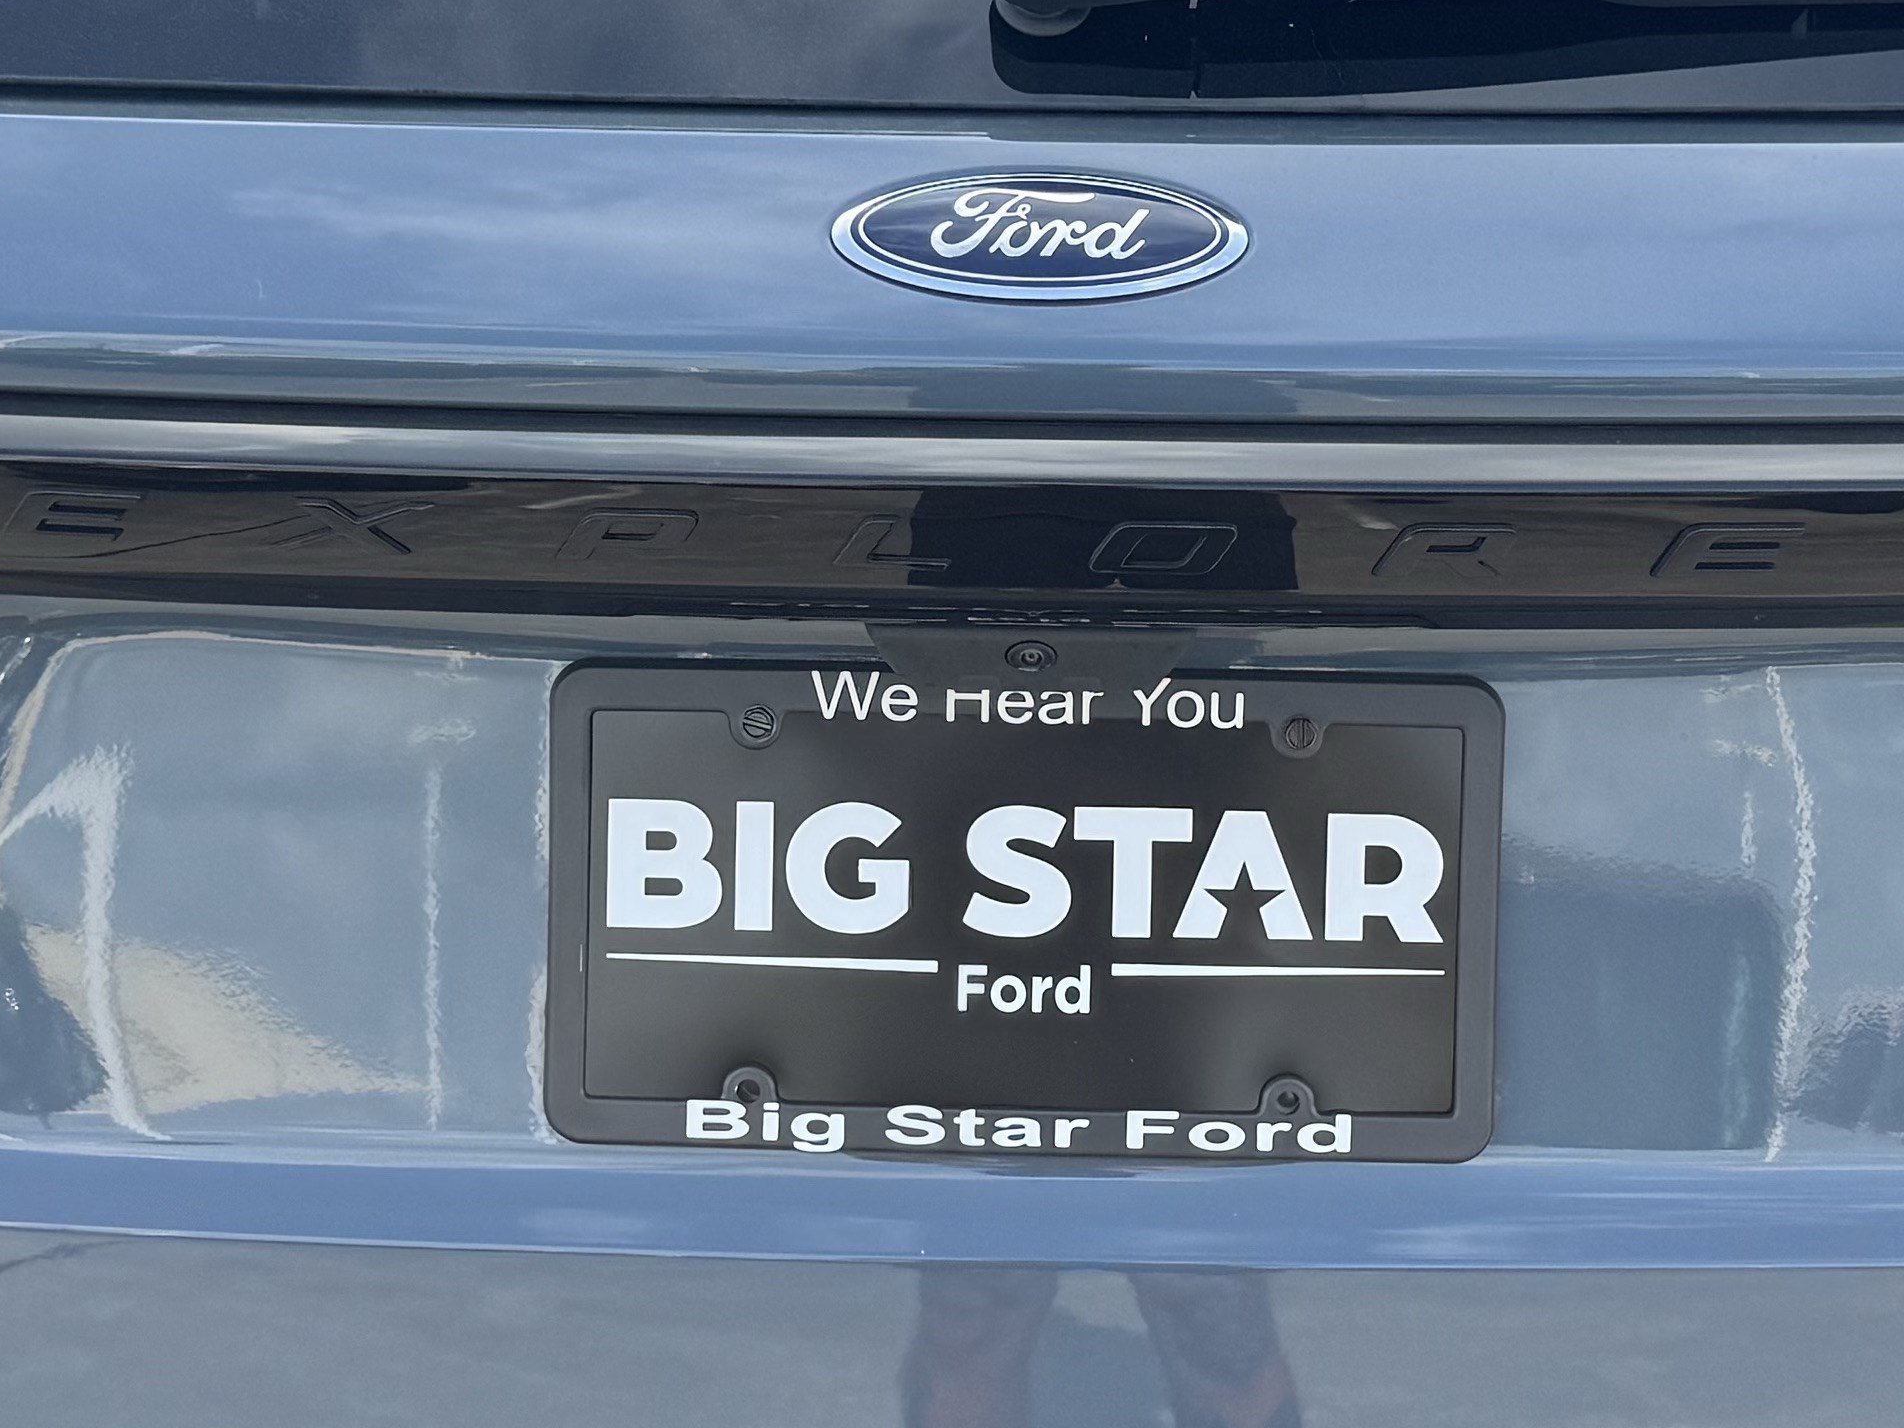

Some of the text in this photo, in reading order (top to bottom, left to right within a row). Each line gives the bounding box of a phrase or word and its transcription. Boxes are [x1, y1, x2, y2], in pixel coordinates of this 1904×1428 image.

[929, 187, 1150, 261] Ford
[810, 669, 1245, 730] We Hear You
[605, 798, 1446, 945] BIG STAR
[956, 964, 1093, 1015] Ford
[684, 1099, 1353, 1156] Big Star Ford
